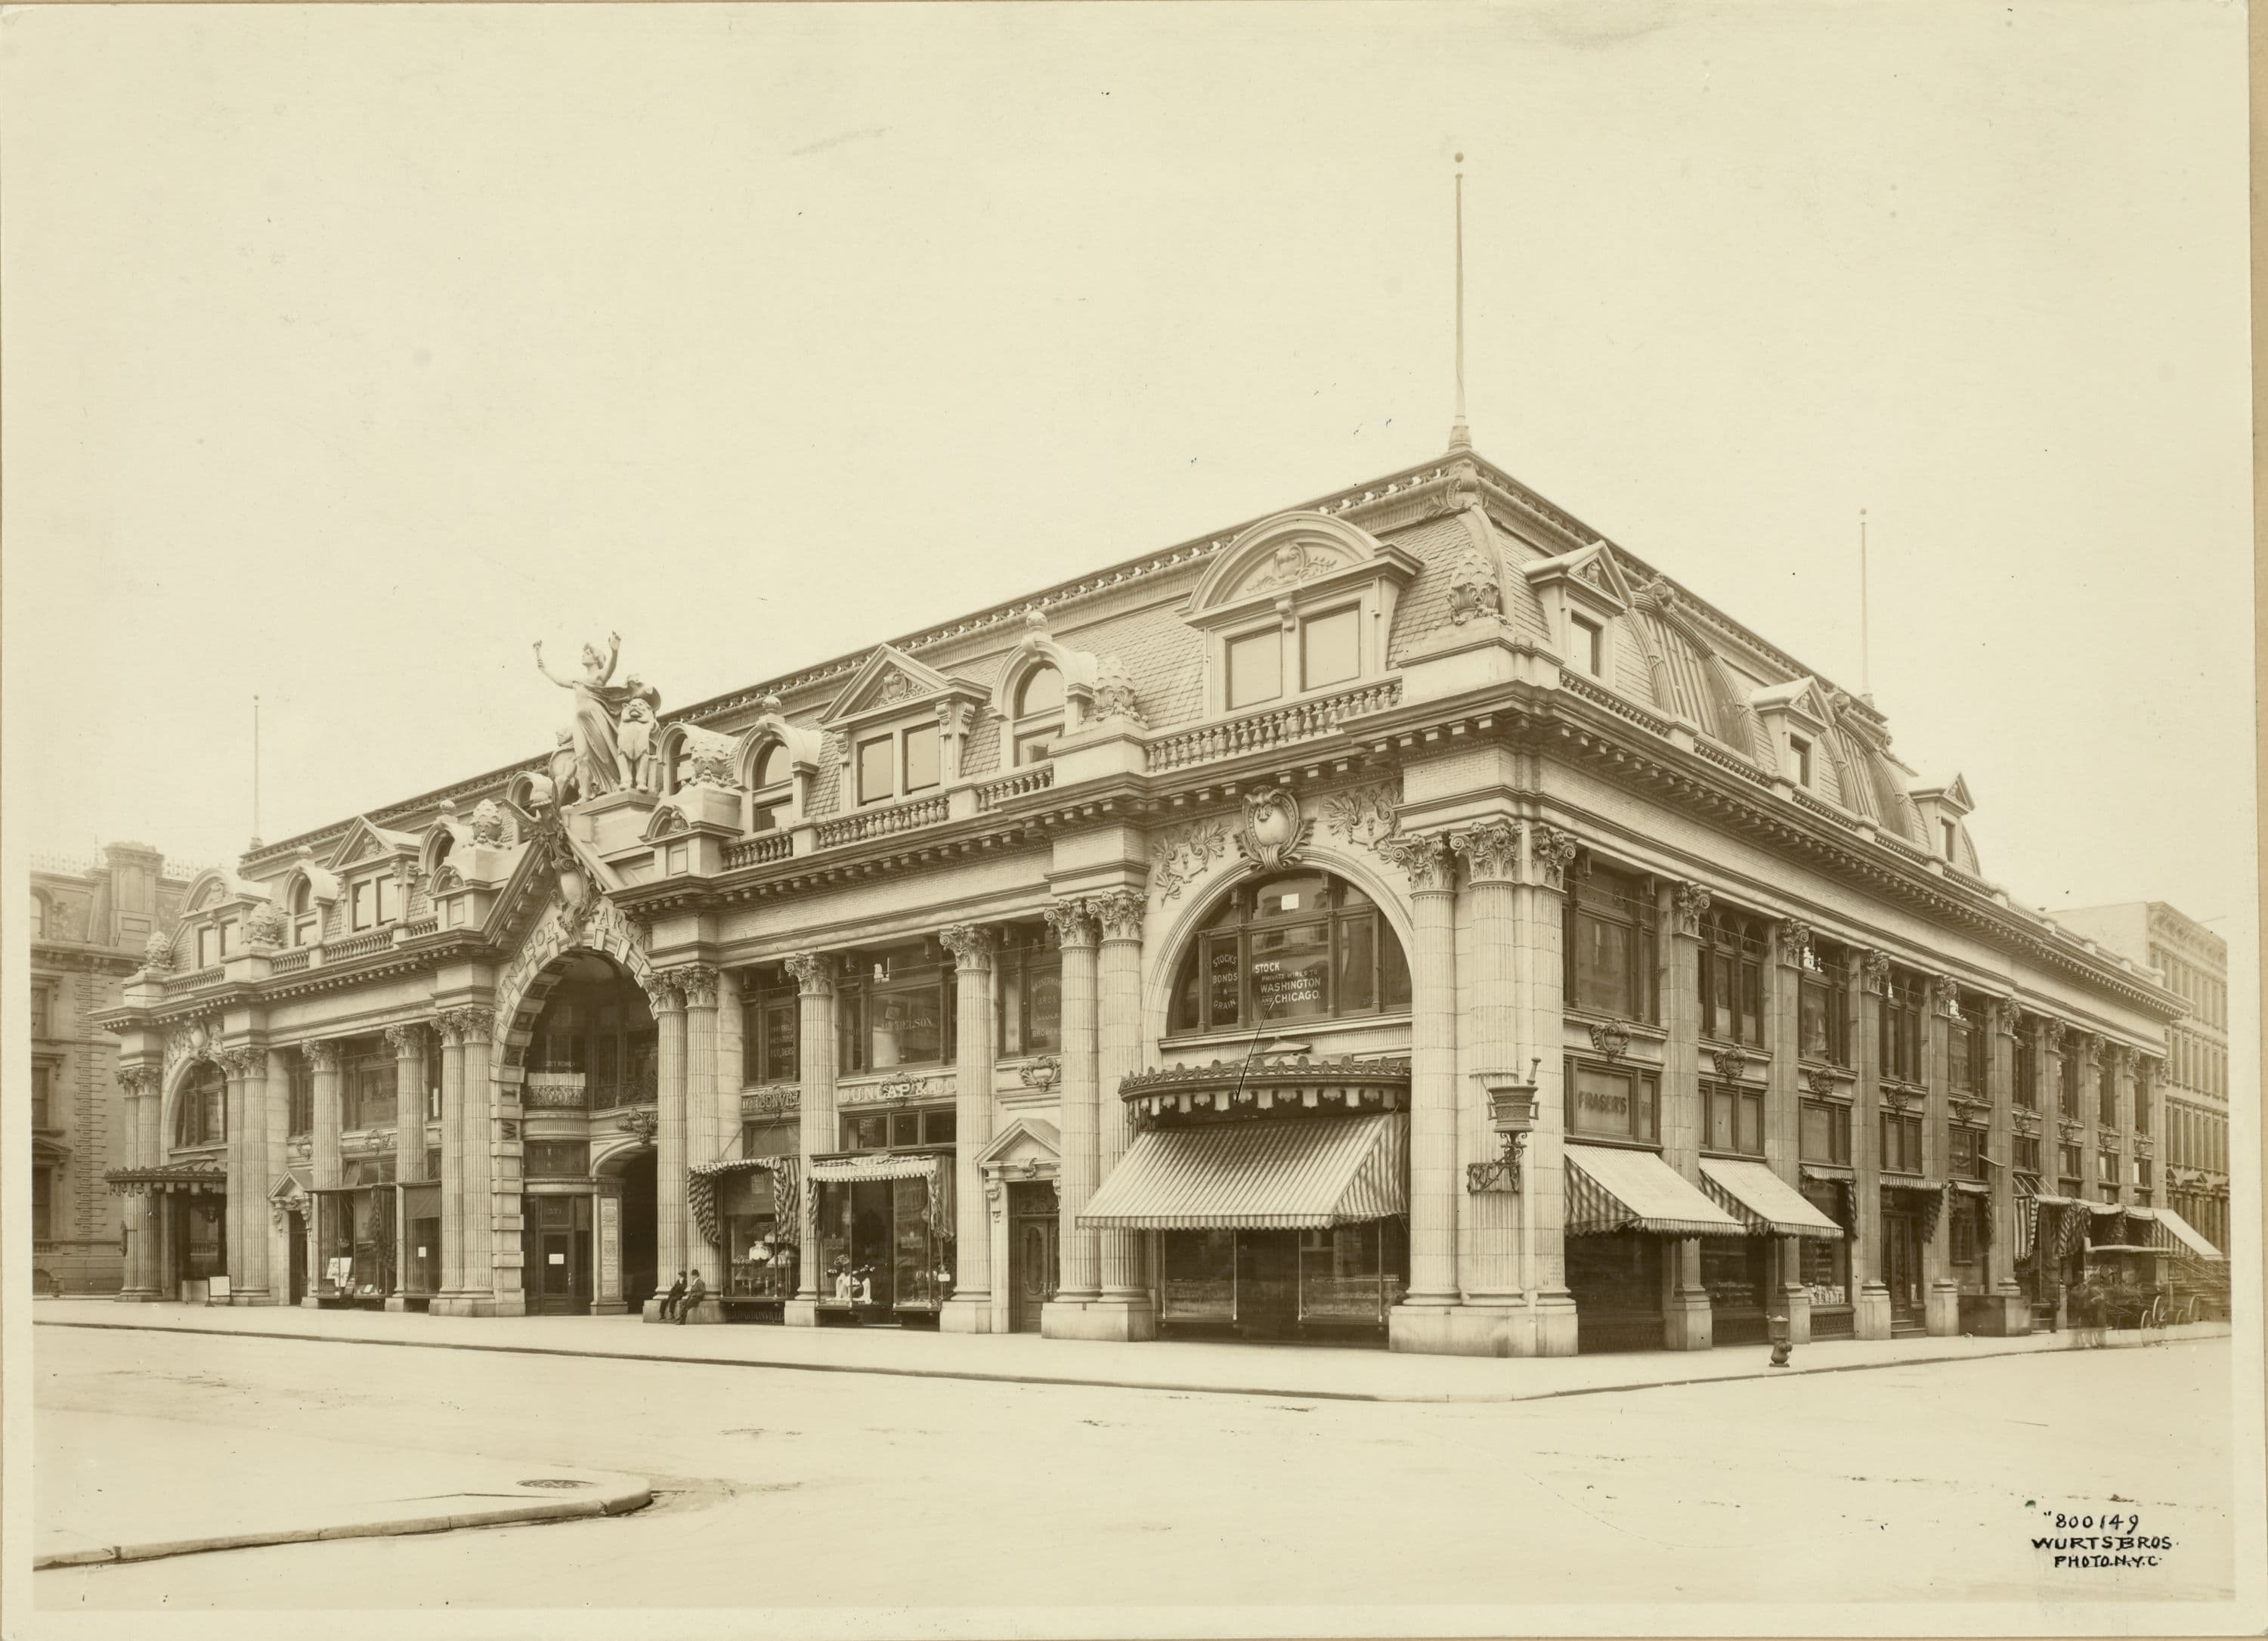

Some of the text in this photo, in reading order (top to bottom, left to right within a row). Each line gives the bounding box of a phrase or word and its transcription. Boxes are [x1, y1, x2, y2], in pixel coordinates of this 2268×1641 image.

[1212, 954, 1238, 968] STOCKS
[1255, 961, 1280, 974] STOCK
[1212, 973, 1238, 983] BONDS
[1261, 977, 1321, 993] WASHINGTON
[1275, 990, 1321, 1004] CHICAGO.
[840, 1083, 910, 1102] DUNLAP
[915, 1082, 927, 1095] &
